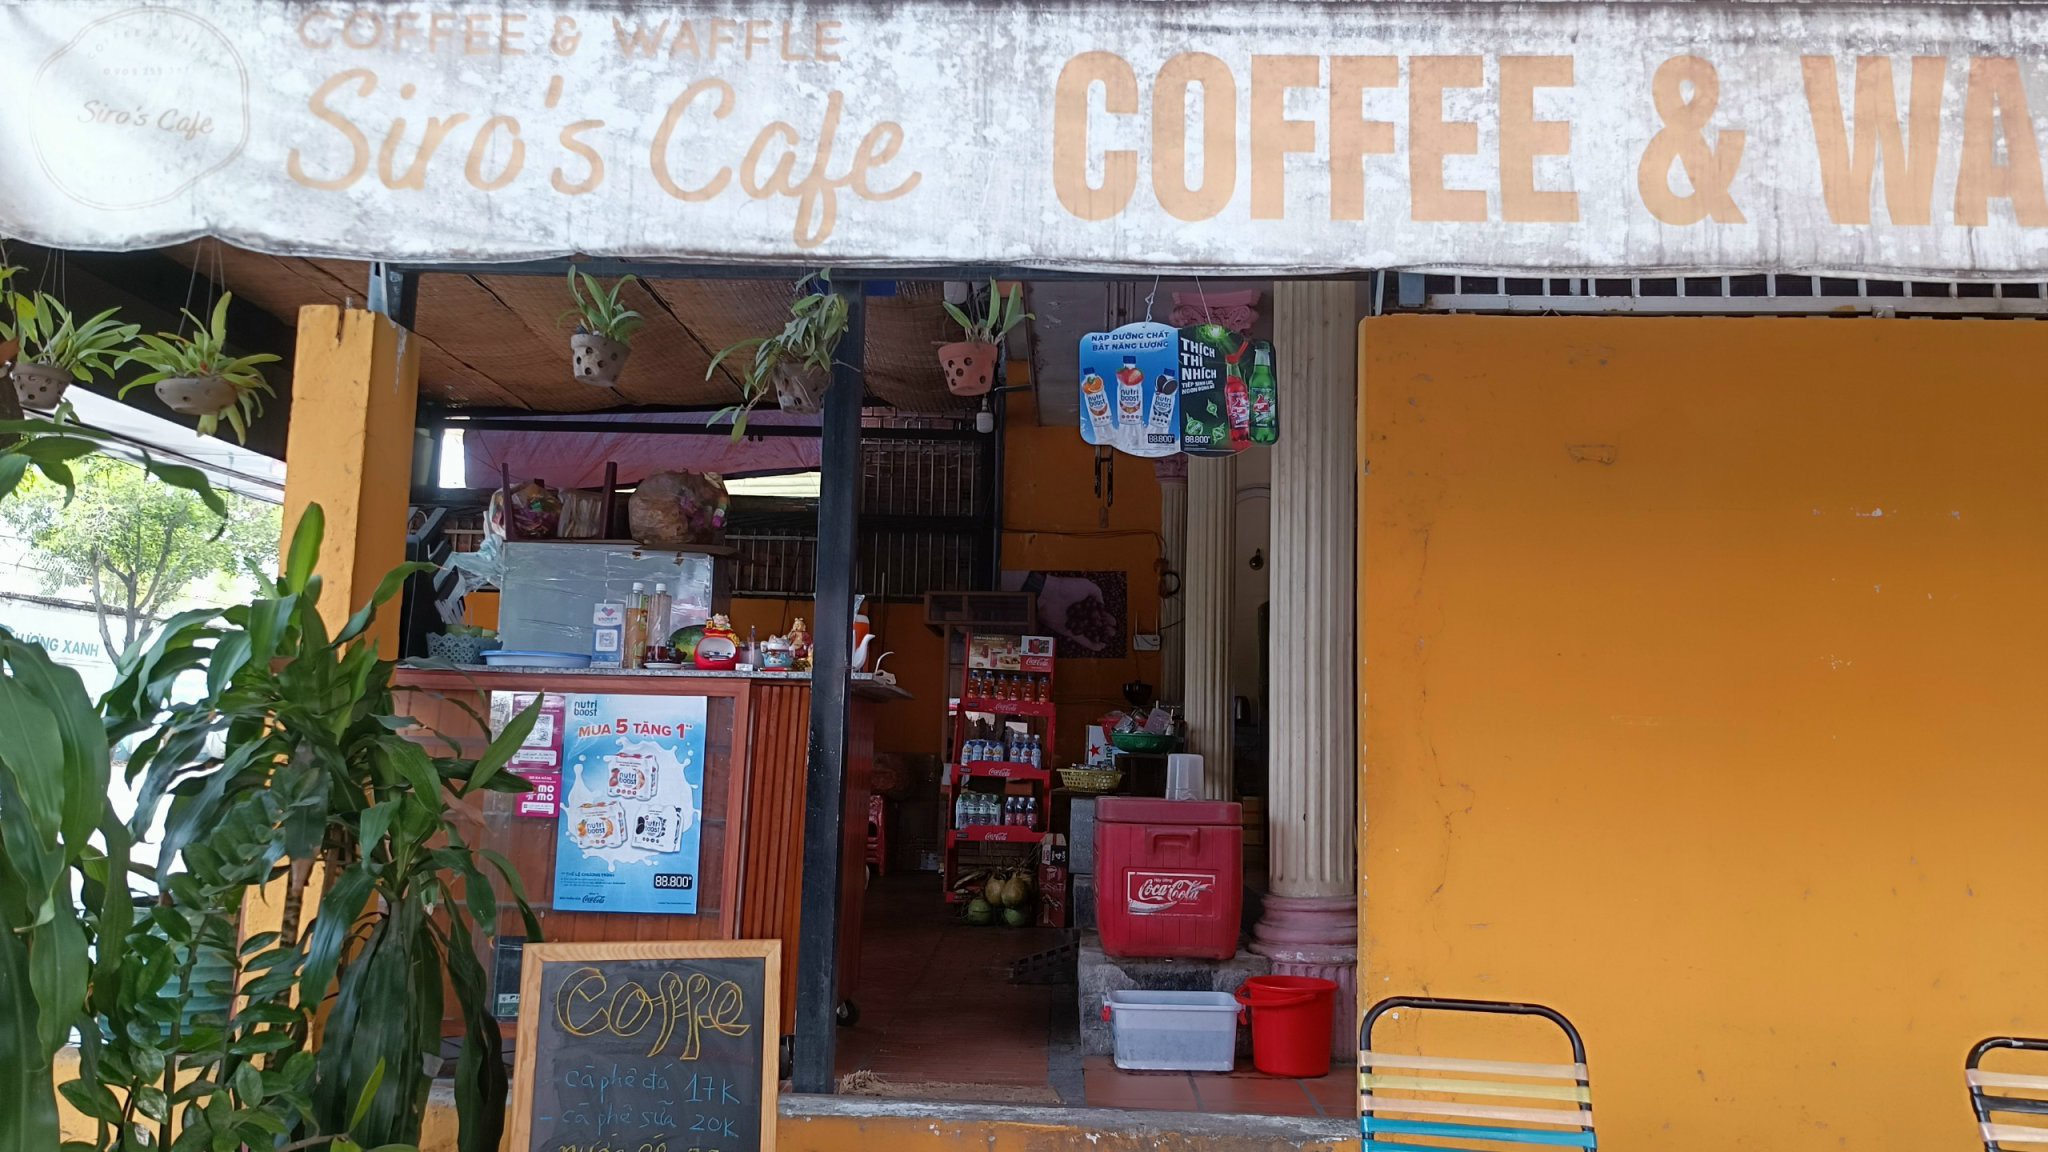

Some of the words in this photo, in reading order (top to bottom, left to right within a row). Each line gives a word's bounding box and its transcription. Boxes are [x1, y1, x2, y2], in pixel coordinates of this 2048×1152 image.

[299, 10, 527, 56] COFFEE
[551, 15, 582, 56] &
[612, 17, 843, 62] WAFFLE
[77, 100, 149, 127] Siro's
[1052, 50, 1581, 222] COFFEE
[1637, 54, 1748, 225] &
[287, 68, 605, 195] Siro's
[650, 78, 922, 248] Cafe
[1180, 337, 1215, 358] THÍCH
[1180, 352, 1204, 367] THÌ
[1181, 367, 1217, 380] NHÍCH
[62, 639, 99, 657] XANH
[574, 700, 598, 708] nutri
[574, 708, 598, 717] boost
[578, 724, 611, 738] MUA
[616, 718, 628, 735] 5
[633, 721, 672, 737] TẶNG
[1138, 878, 1206, 902] Coca-Cola
